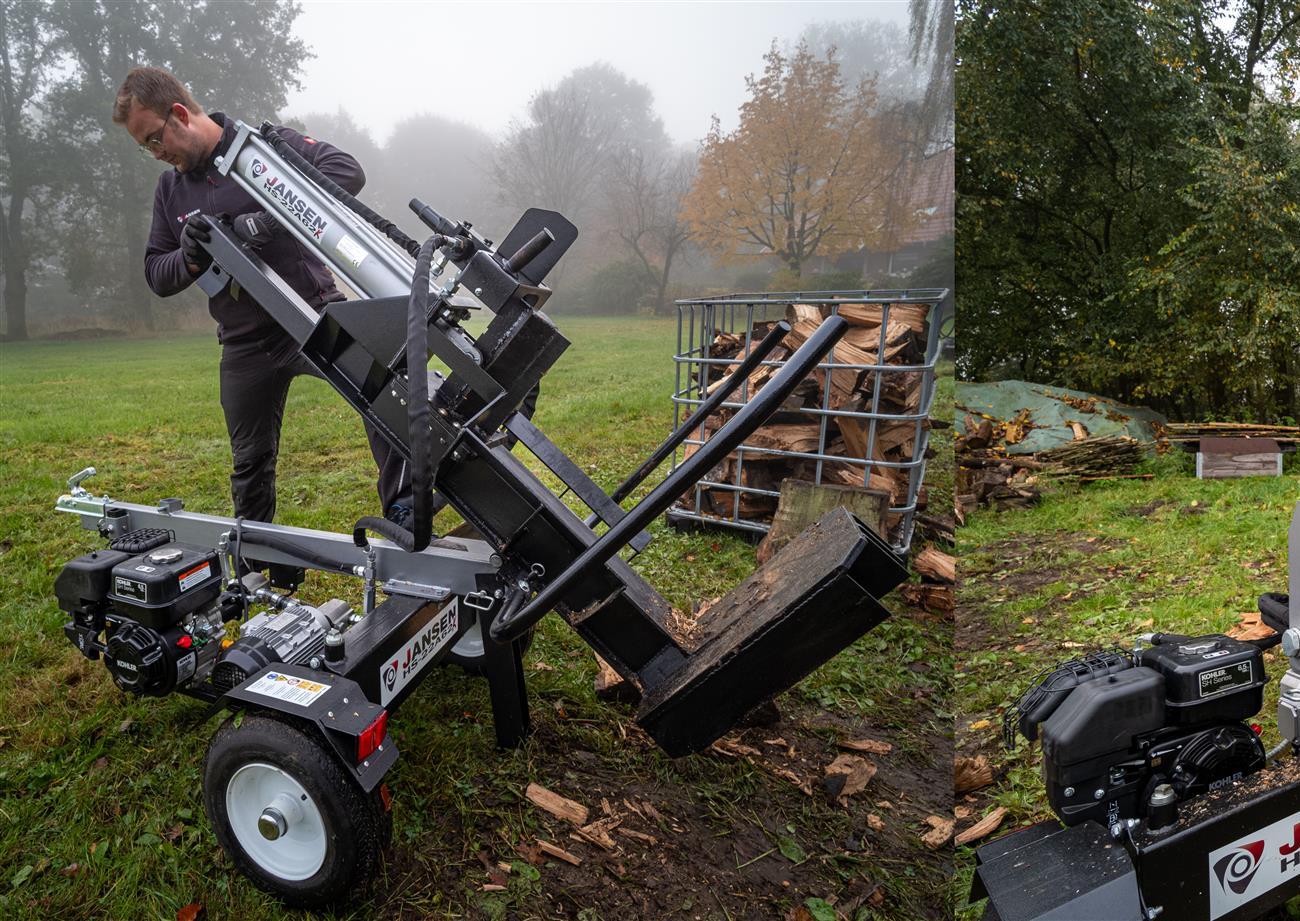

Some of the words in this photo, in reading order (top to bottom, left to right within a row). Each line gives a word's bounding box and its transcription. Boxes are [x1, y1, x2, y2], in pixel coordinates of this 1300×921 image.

[266, 176, 328, 230] JANSEN
[403, 605, 456, 669] JANSEN
[117, 659, 138, 672] KOHLER
[1201, 669, 1226, 681] KOHLER
[1209, 771, 1243, 791] KOHLER
